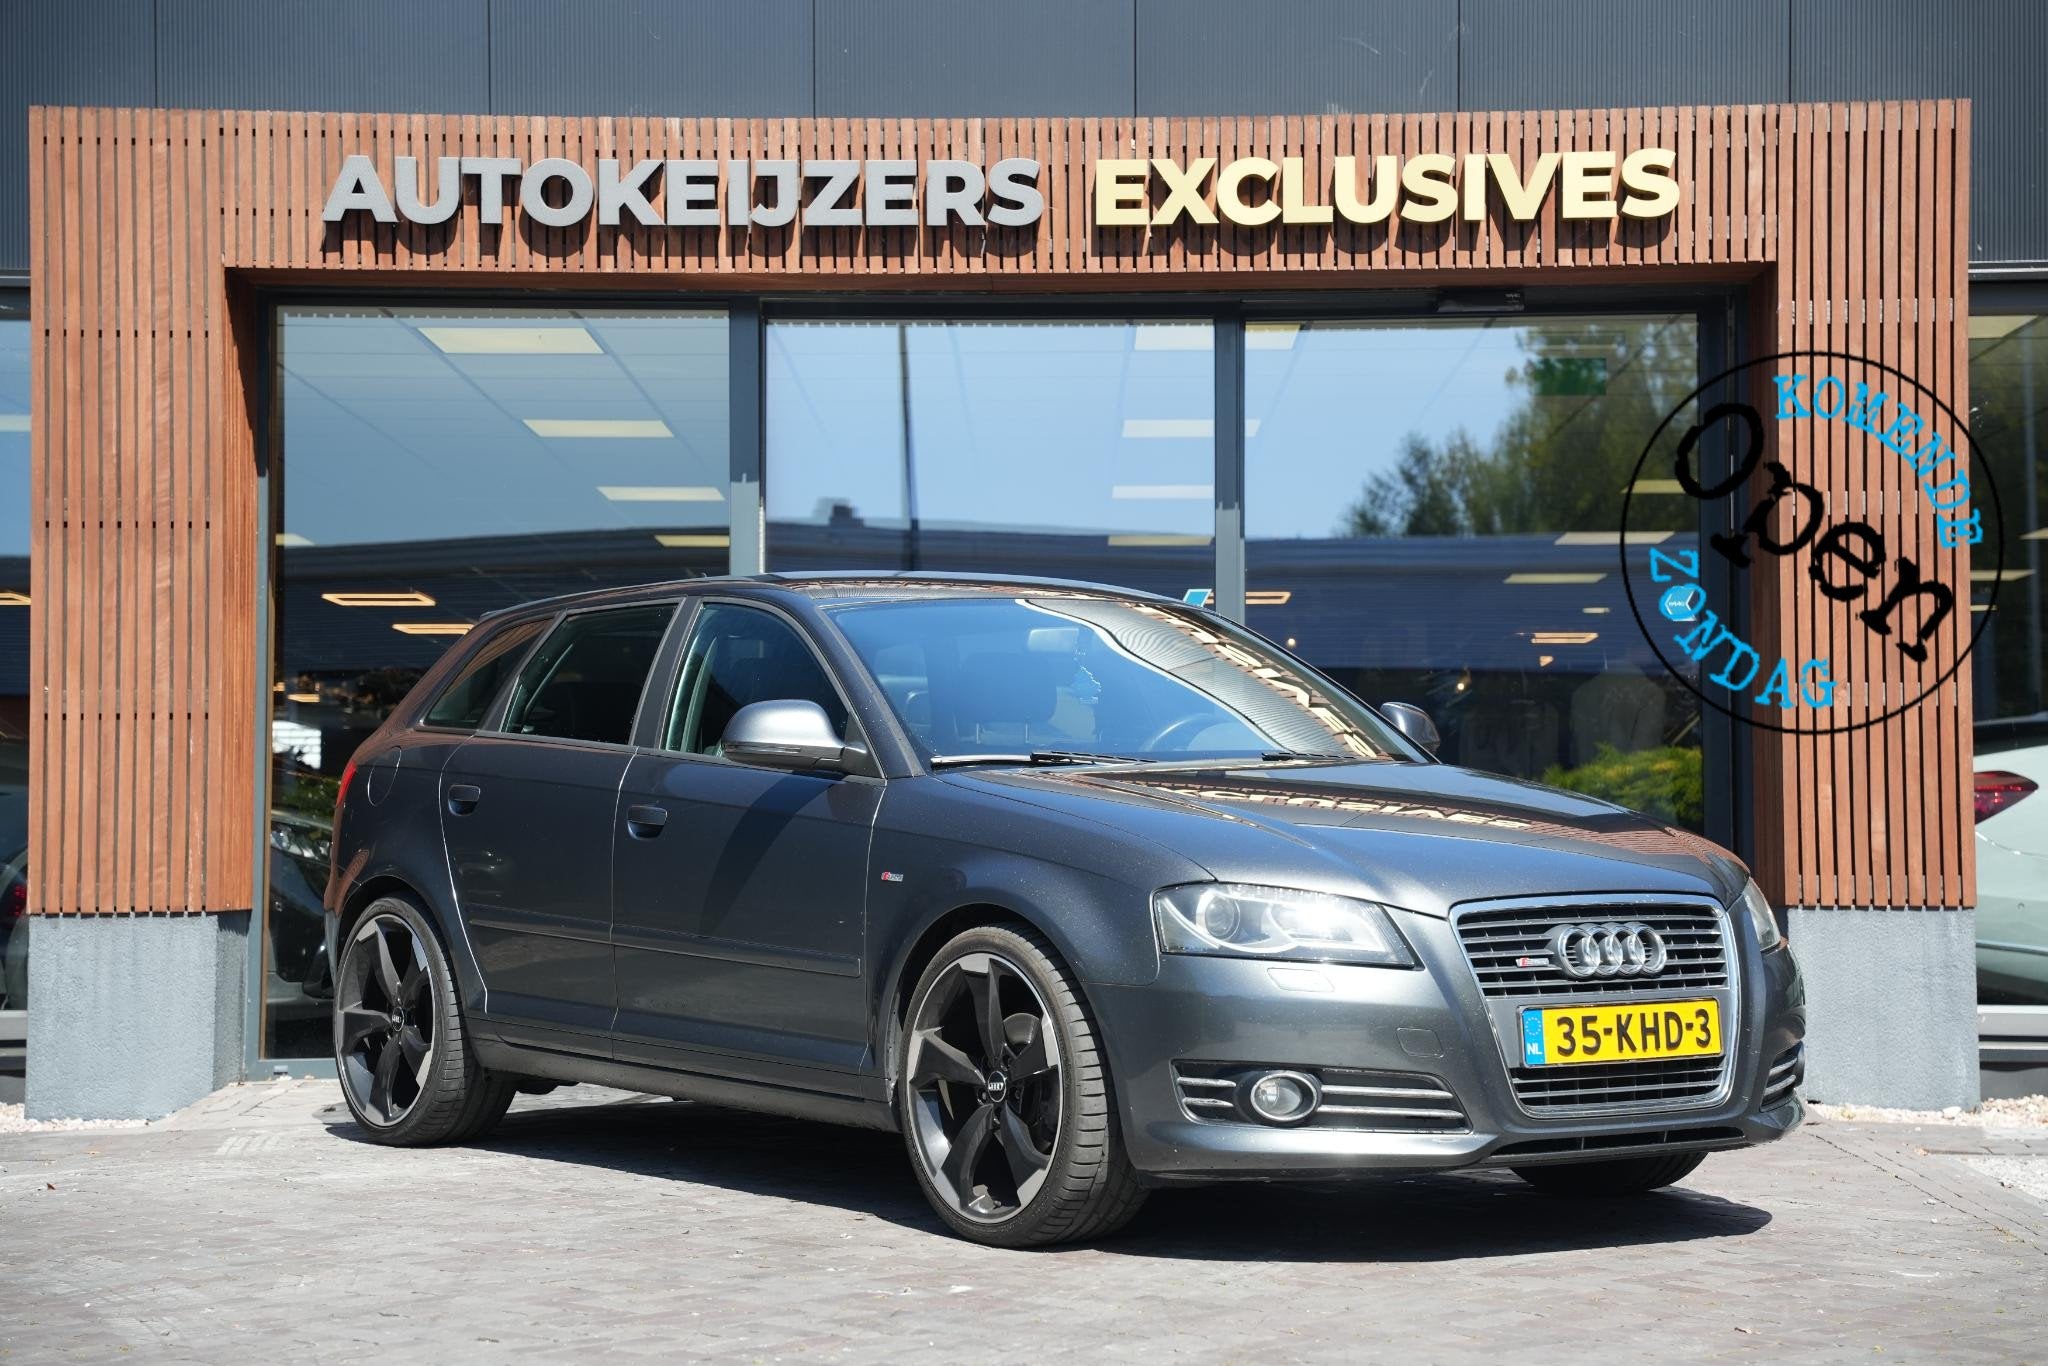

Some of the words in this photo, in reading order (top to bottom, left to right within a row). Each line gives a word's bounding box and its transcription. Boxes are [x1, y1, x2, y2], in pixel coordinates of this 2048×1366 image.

[322, 155, 1045, 227] AUTOKEIJZERS
[1095, 148, 1681, 226] EXCLUSIVES
[1527, 1042, 1543, 1055] NL
[1556, 1008, 1712, 1056] 35-KHD-3
